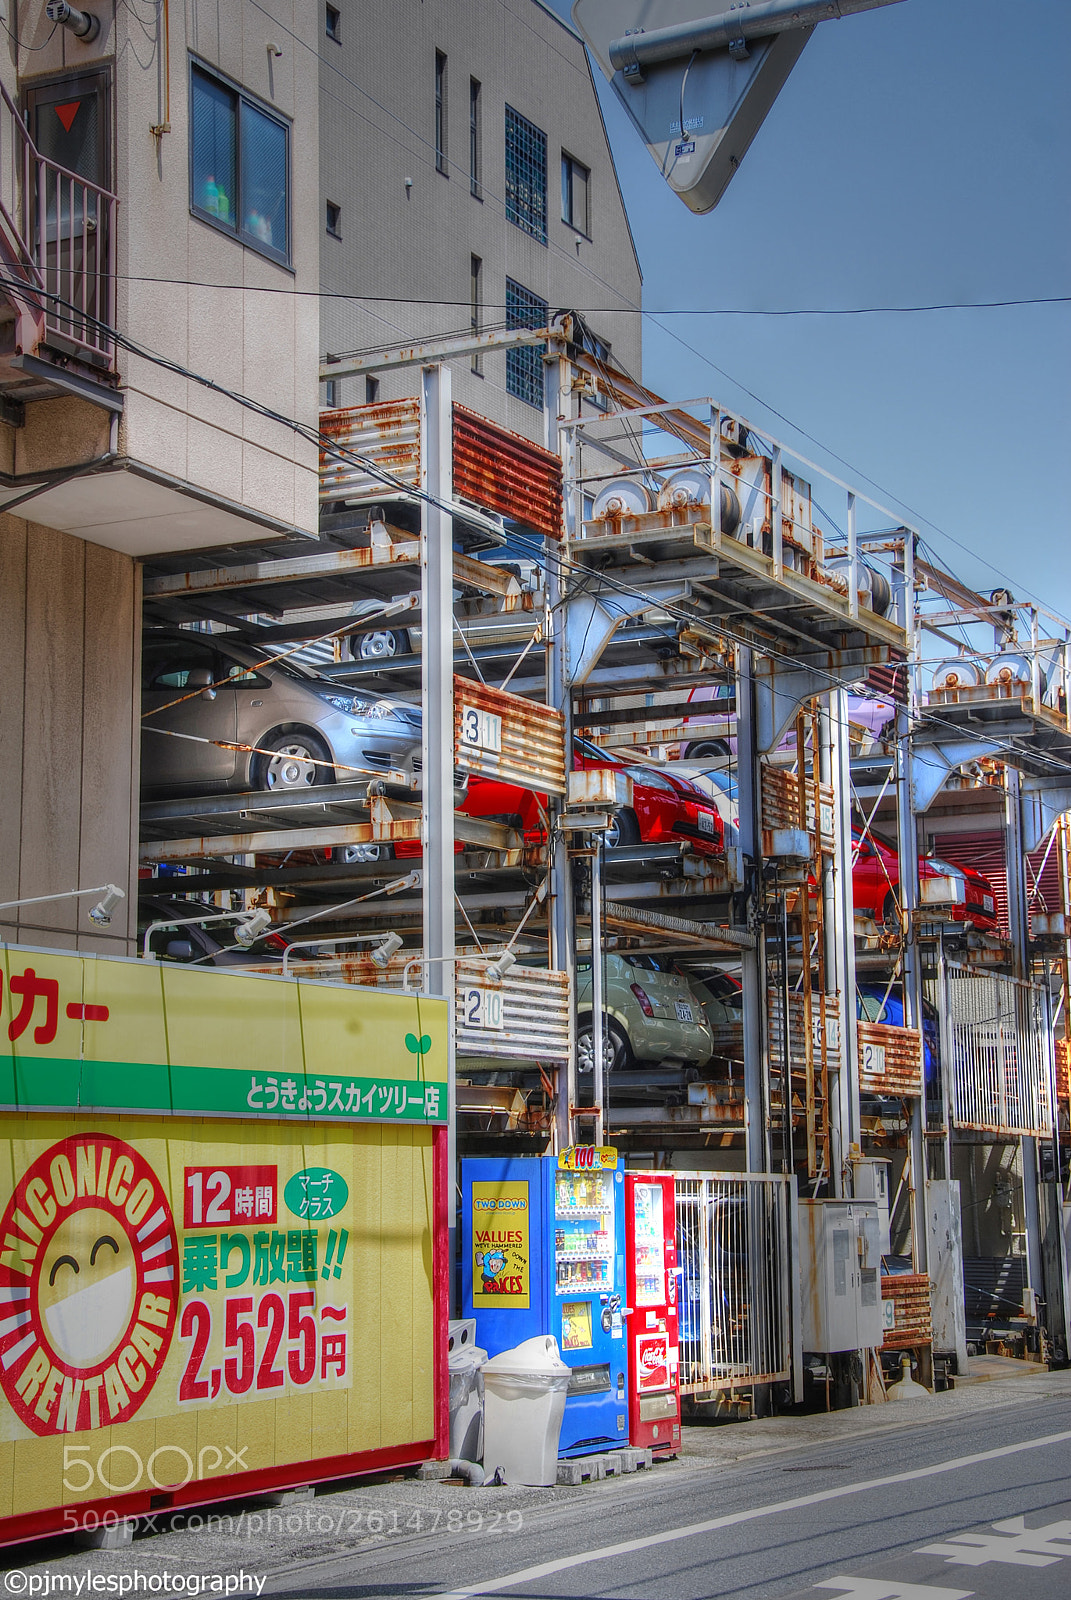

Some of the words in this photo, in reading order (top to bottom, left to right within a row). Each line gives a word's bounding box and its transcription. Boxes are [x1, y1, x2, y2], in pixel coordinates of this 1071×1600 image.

[467, 711, 478, 742] 3
[486, 716, 497, 748] 11
[469, 990, 480, 1023] 2
[487, 993, 500, 1025] 10
[866, 1046, 872, 1070] 2
[247, 1076, 440, 1118] とうきょうスカイツリー店
[298, 1173, 334, 1194] マーチ
[187, 1170, 273, 1224] 12時間
[299, 1197, 334, 1217] クラス
[476, 1200, 496, 1208] TWO
[498, 1200, 526, 1208] DOWN
[0, 1144, 155, 1278] NICONICO
[475, 1230, 523, 1243] VALUES
[511, 1251, 527, 1265] DOWN
[513, 1263, 524, 1273] THE
[484, 1274, 523, 1294] PRICES
[885, 1301, 893, 1328] 9
[14, 1292, 171, 1432] RENTACAR
